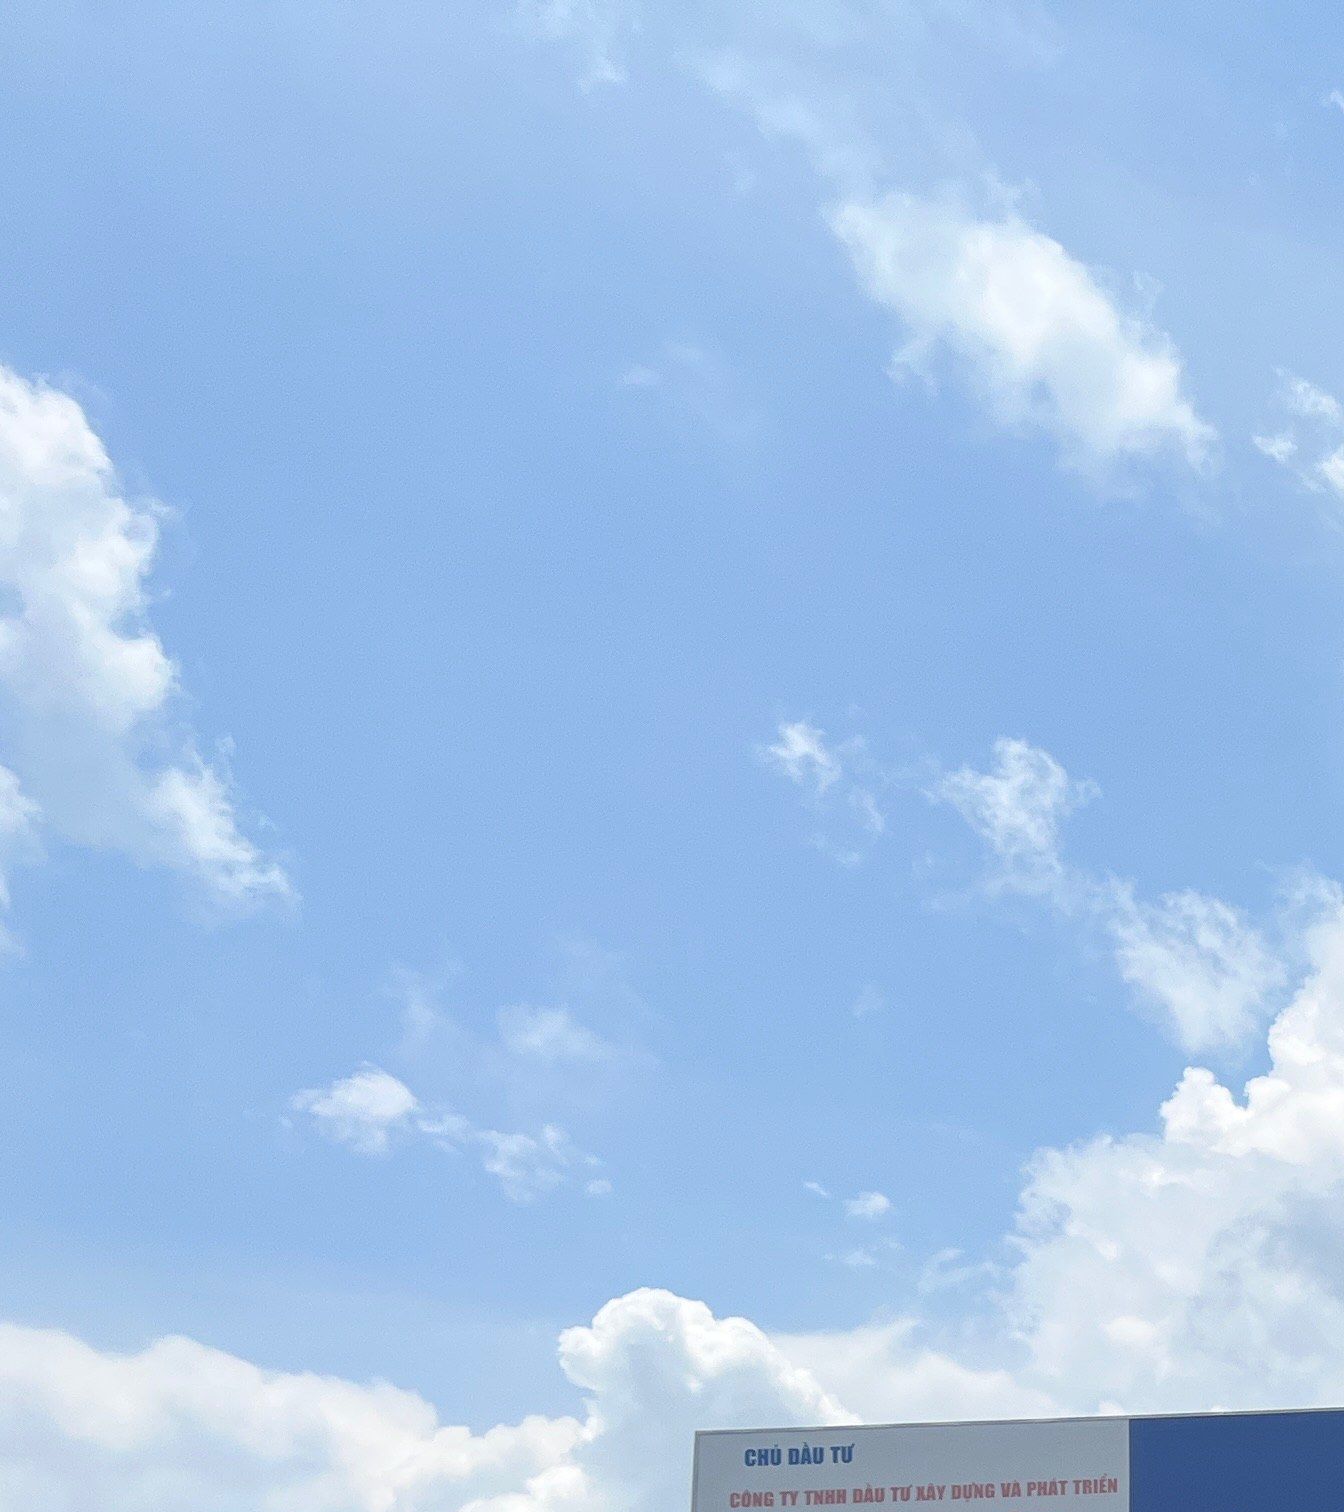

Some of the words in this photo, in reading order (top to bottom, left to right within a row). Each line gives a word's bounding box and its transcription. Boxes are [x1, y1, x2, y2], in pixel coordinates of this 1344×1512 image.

[830, 1443, 855, 1464] TƯ
[730, 1489, 774, 1508] CÔNG
[779, 1490, 799, 1506] TY
[804, 1488, 847, 1506] TNHH
[890, 1484, 913, 1502] TƯ
[916, 1483, 946, 1501] XÂY
[1000, 1480, 1022, 1498] VÀ
